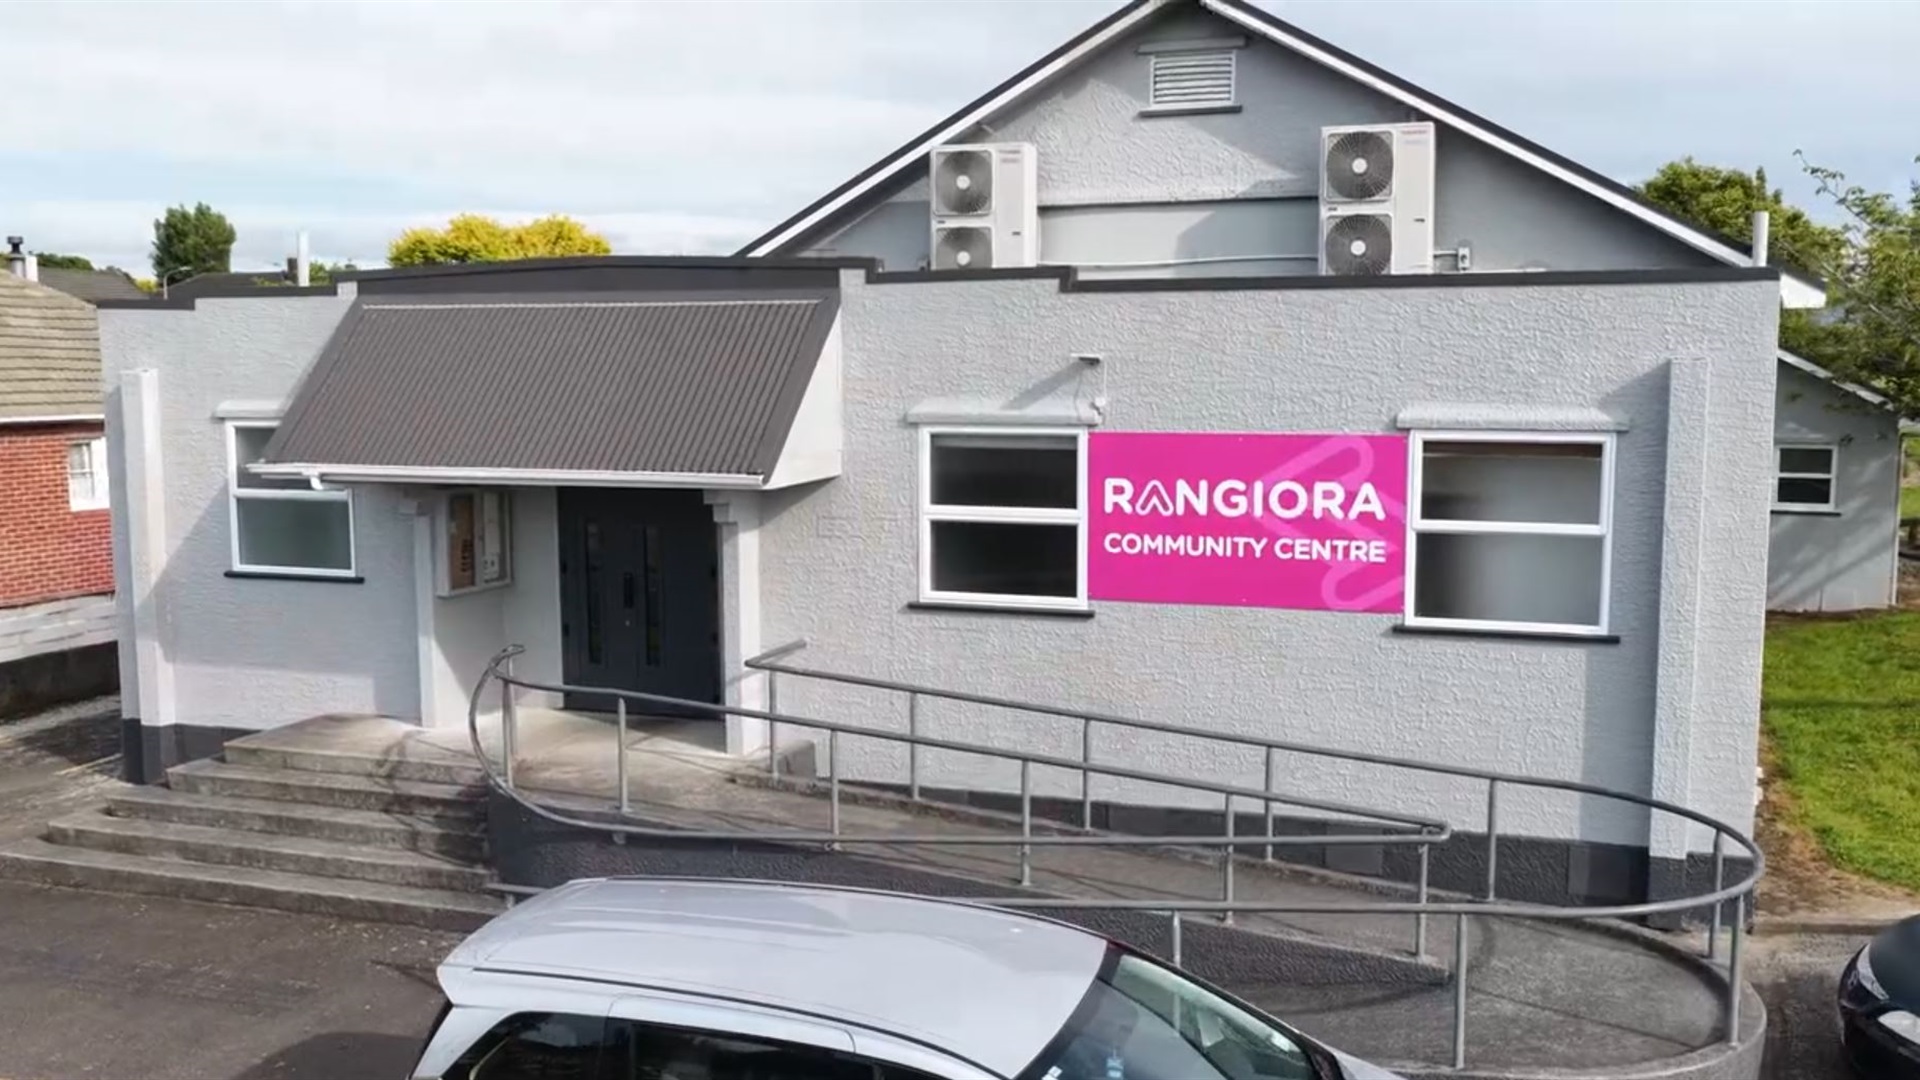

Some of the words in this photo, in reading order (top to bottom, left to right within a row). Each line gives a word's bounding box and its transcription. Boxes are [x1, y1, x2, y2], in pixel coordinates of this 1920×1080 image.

[1103, 477, 1386, 521] RANGIORA
[1103, 532, 1268, 558] COMMUNITY
[1274, 538, 1387, 563] CENTRE
